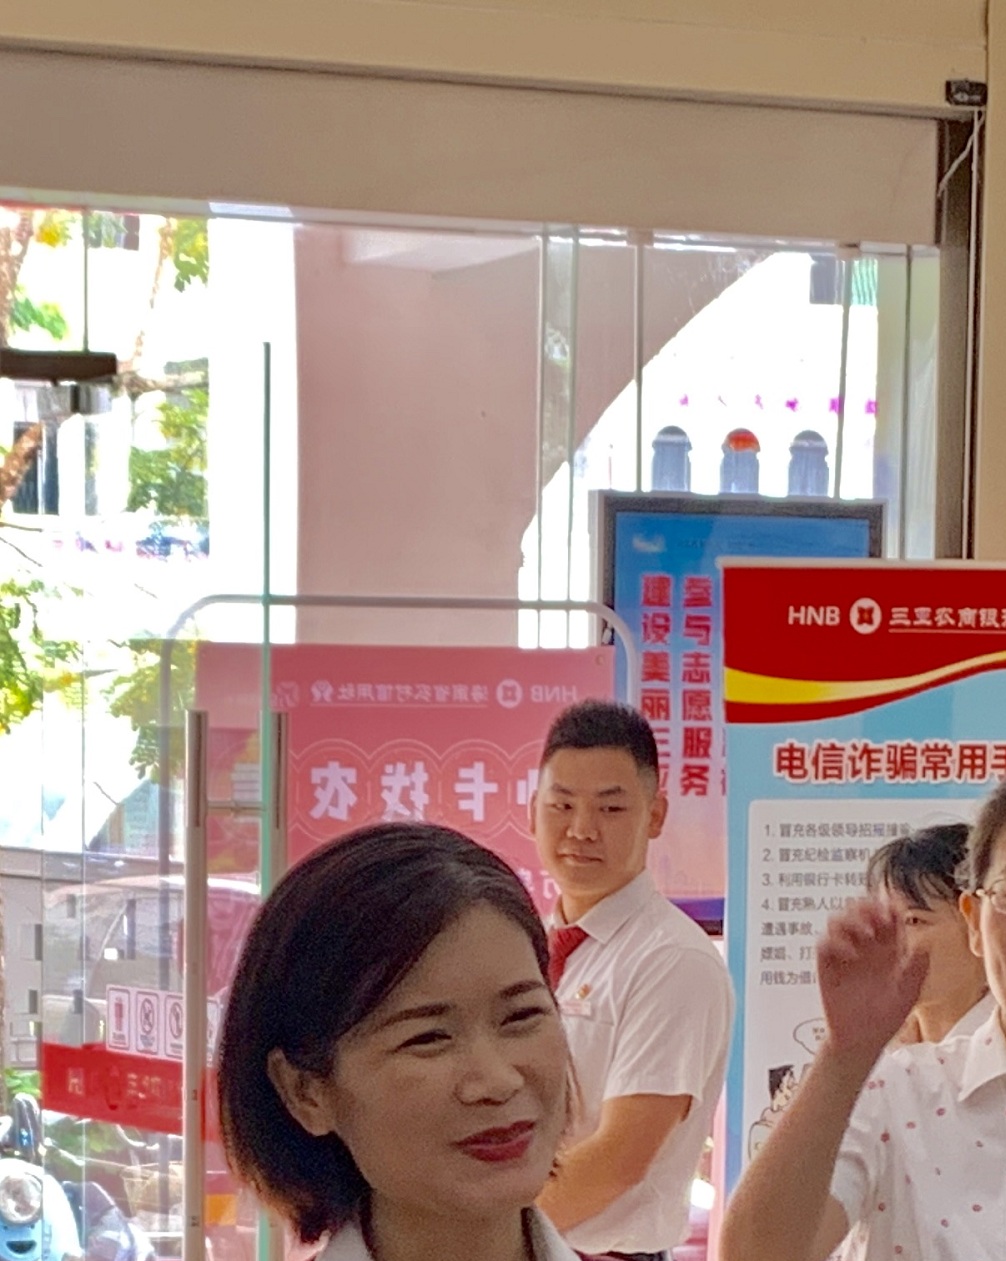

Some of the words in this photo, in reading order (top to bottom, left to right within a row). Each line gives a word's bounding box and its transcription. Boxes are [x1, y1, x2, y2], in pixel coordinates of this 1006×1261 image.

[788, 606, 841, 626] HNB
[680, 575, 714, 797] 参与志愿服务
